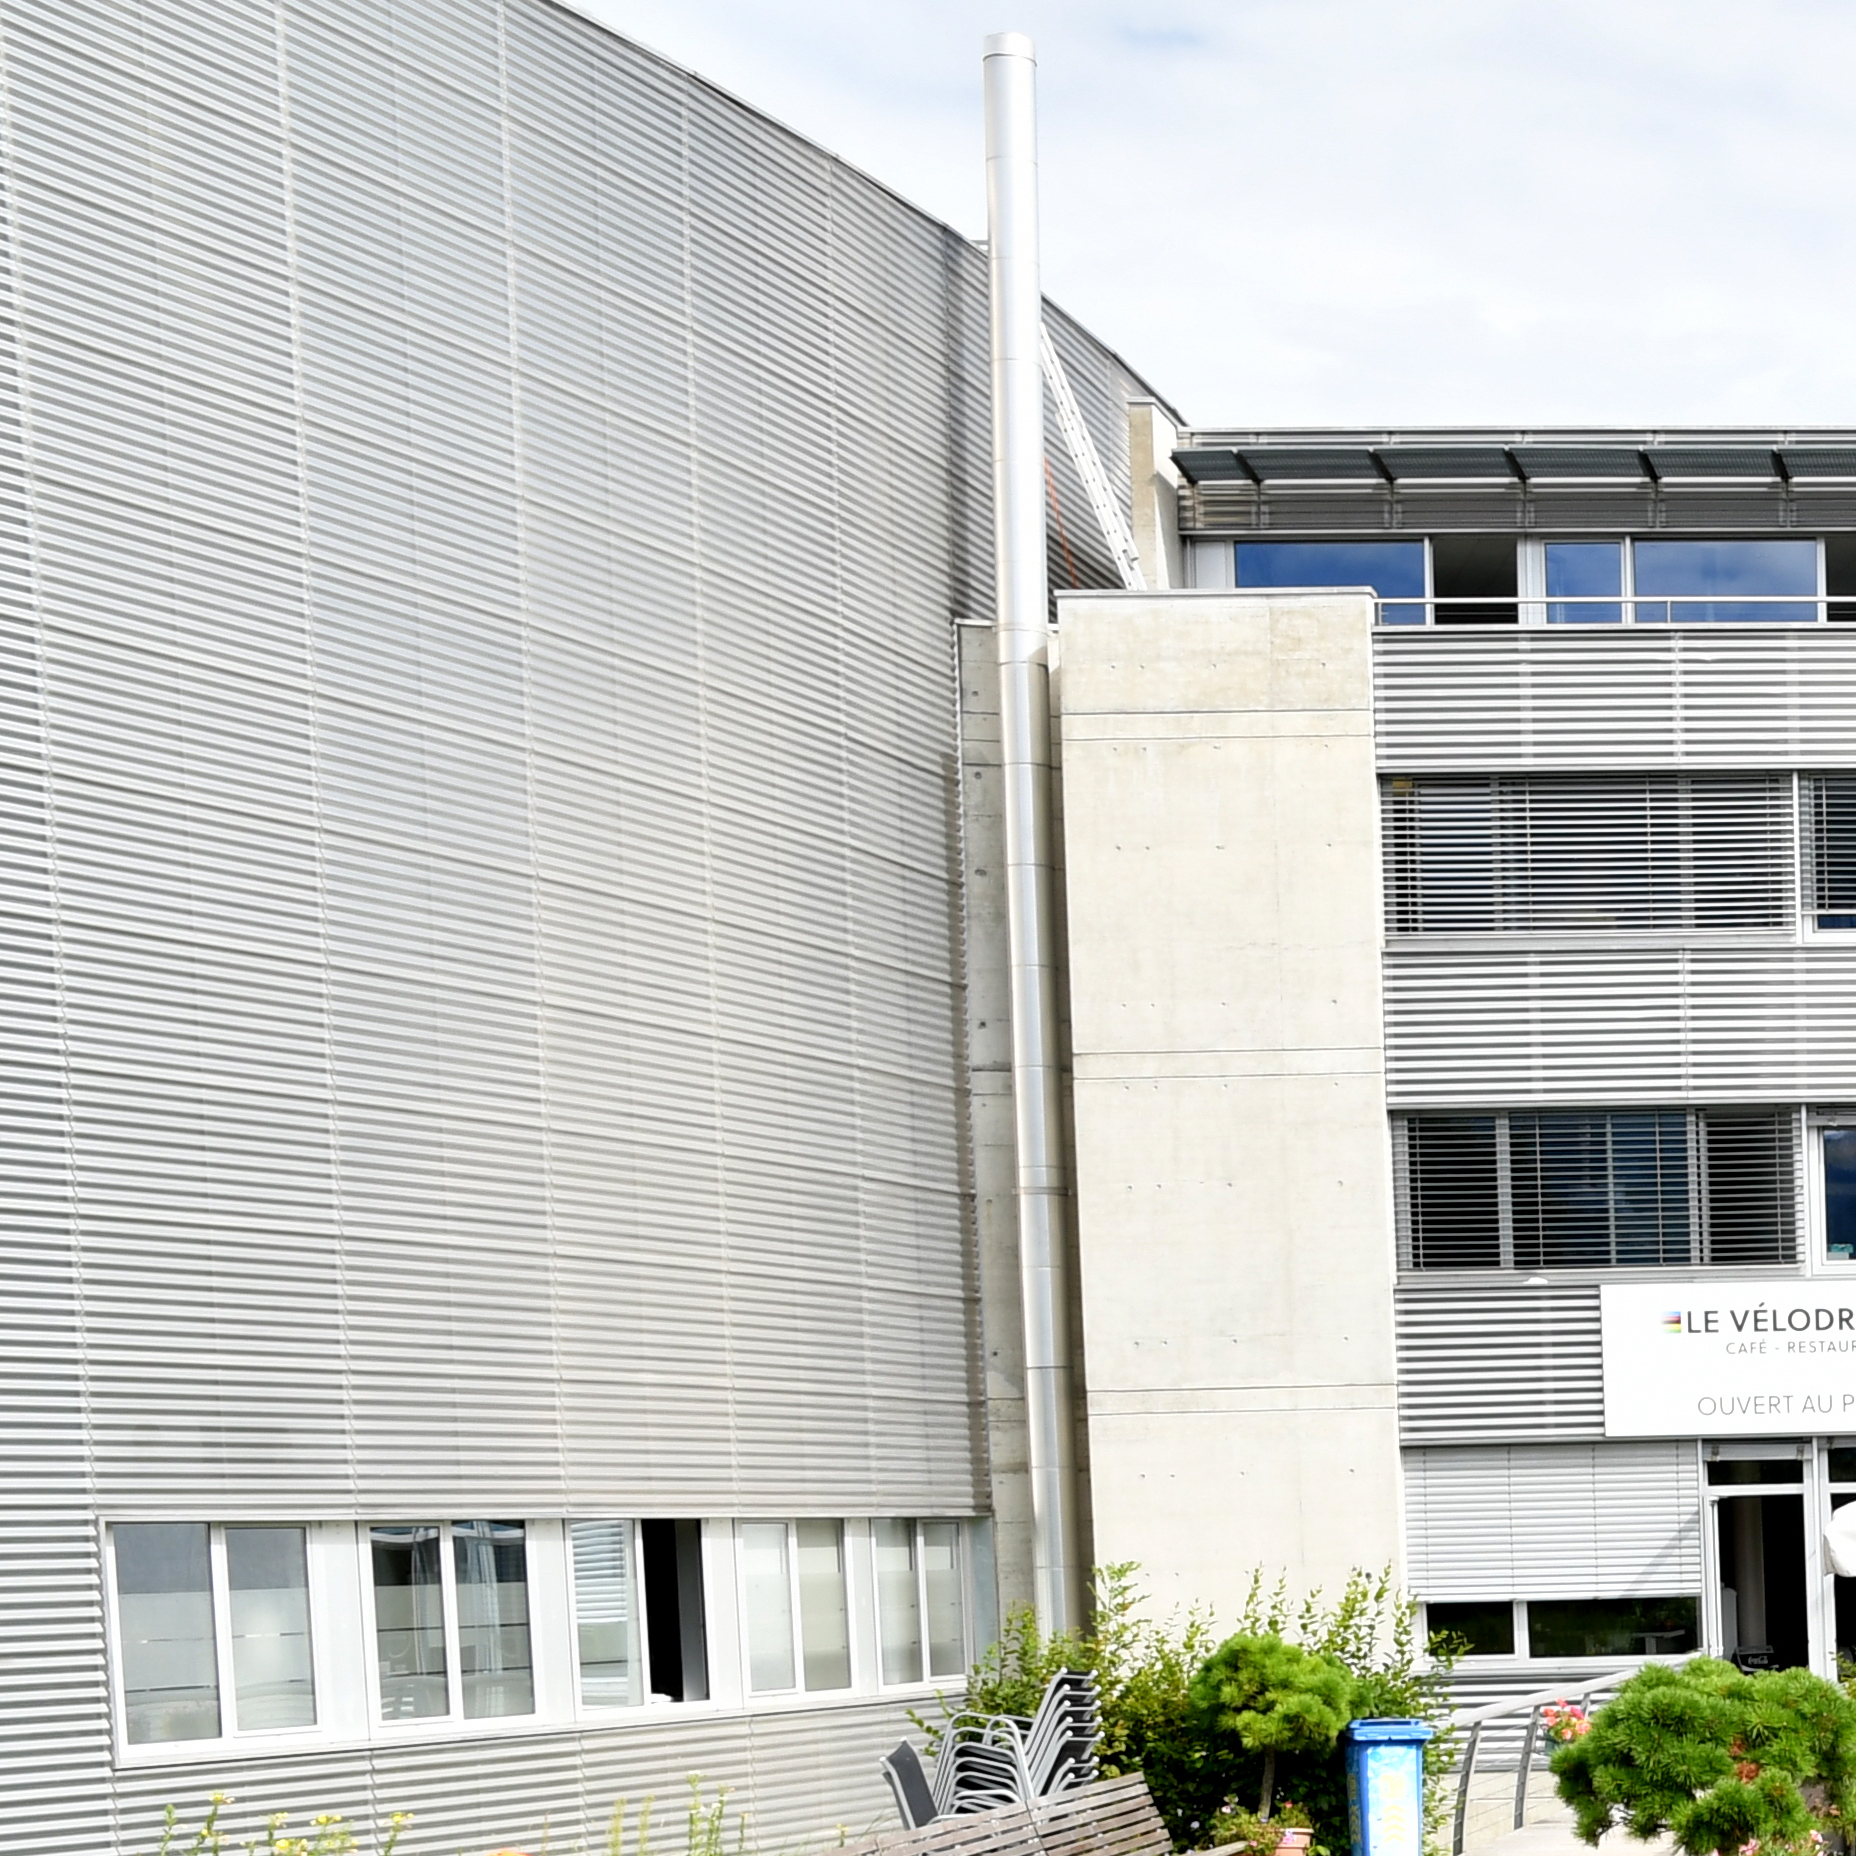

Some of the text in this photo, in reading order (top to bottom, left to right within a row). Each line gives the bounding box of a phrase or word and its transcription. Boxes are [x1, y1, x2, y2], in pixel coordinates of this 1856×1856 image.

[1688, 1311, 1719, 1333] LE
[1726, 1339, 1766, 1354] CAFÉ
[1698, 1395, 1793, 1415] OUVERT
[1802, 1395, 1832, 1413] AU
